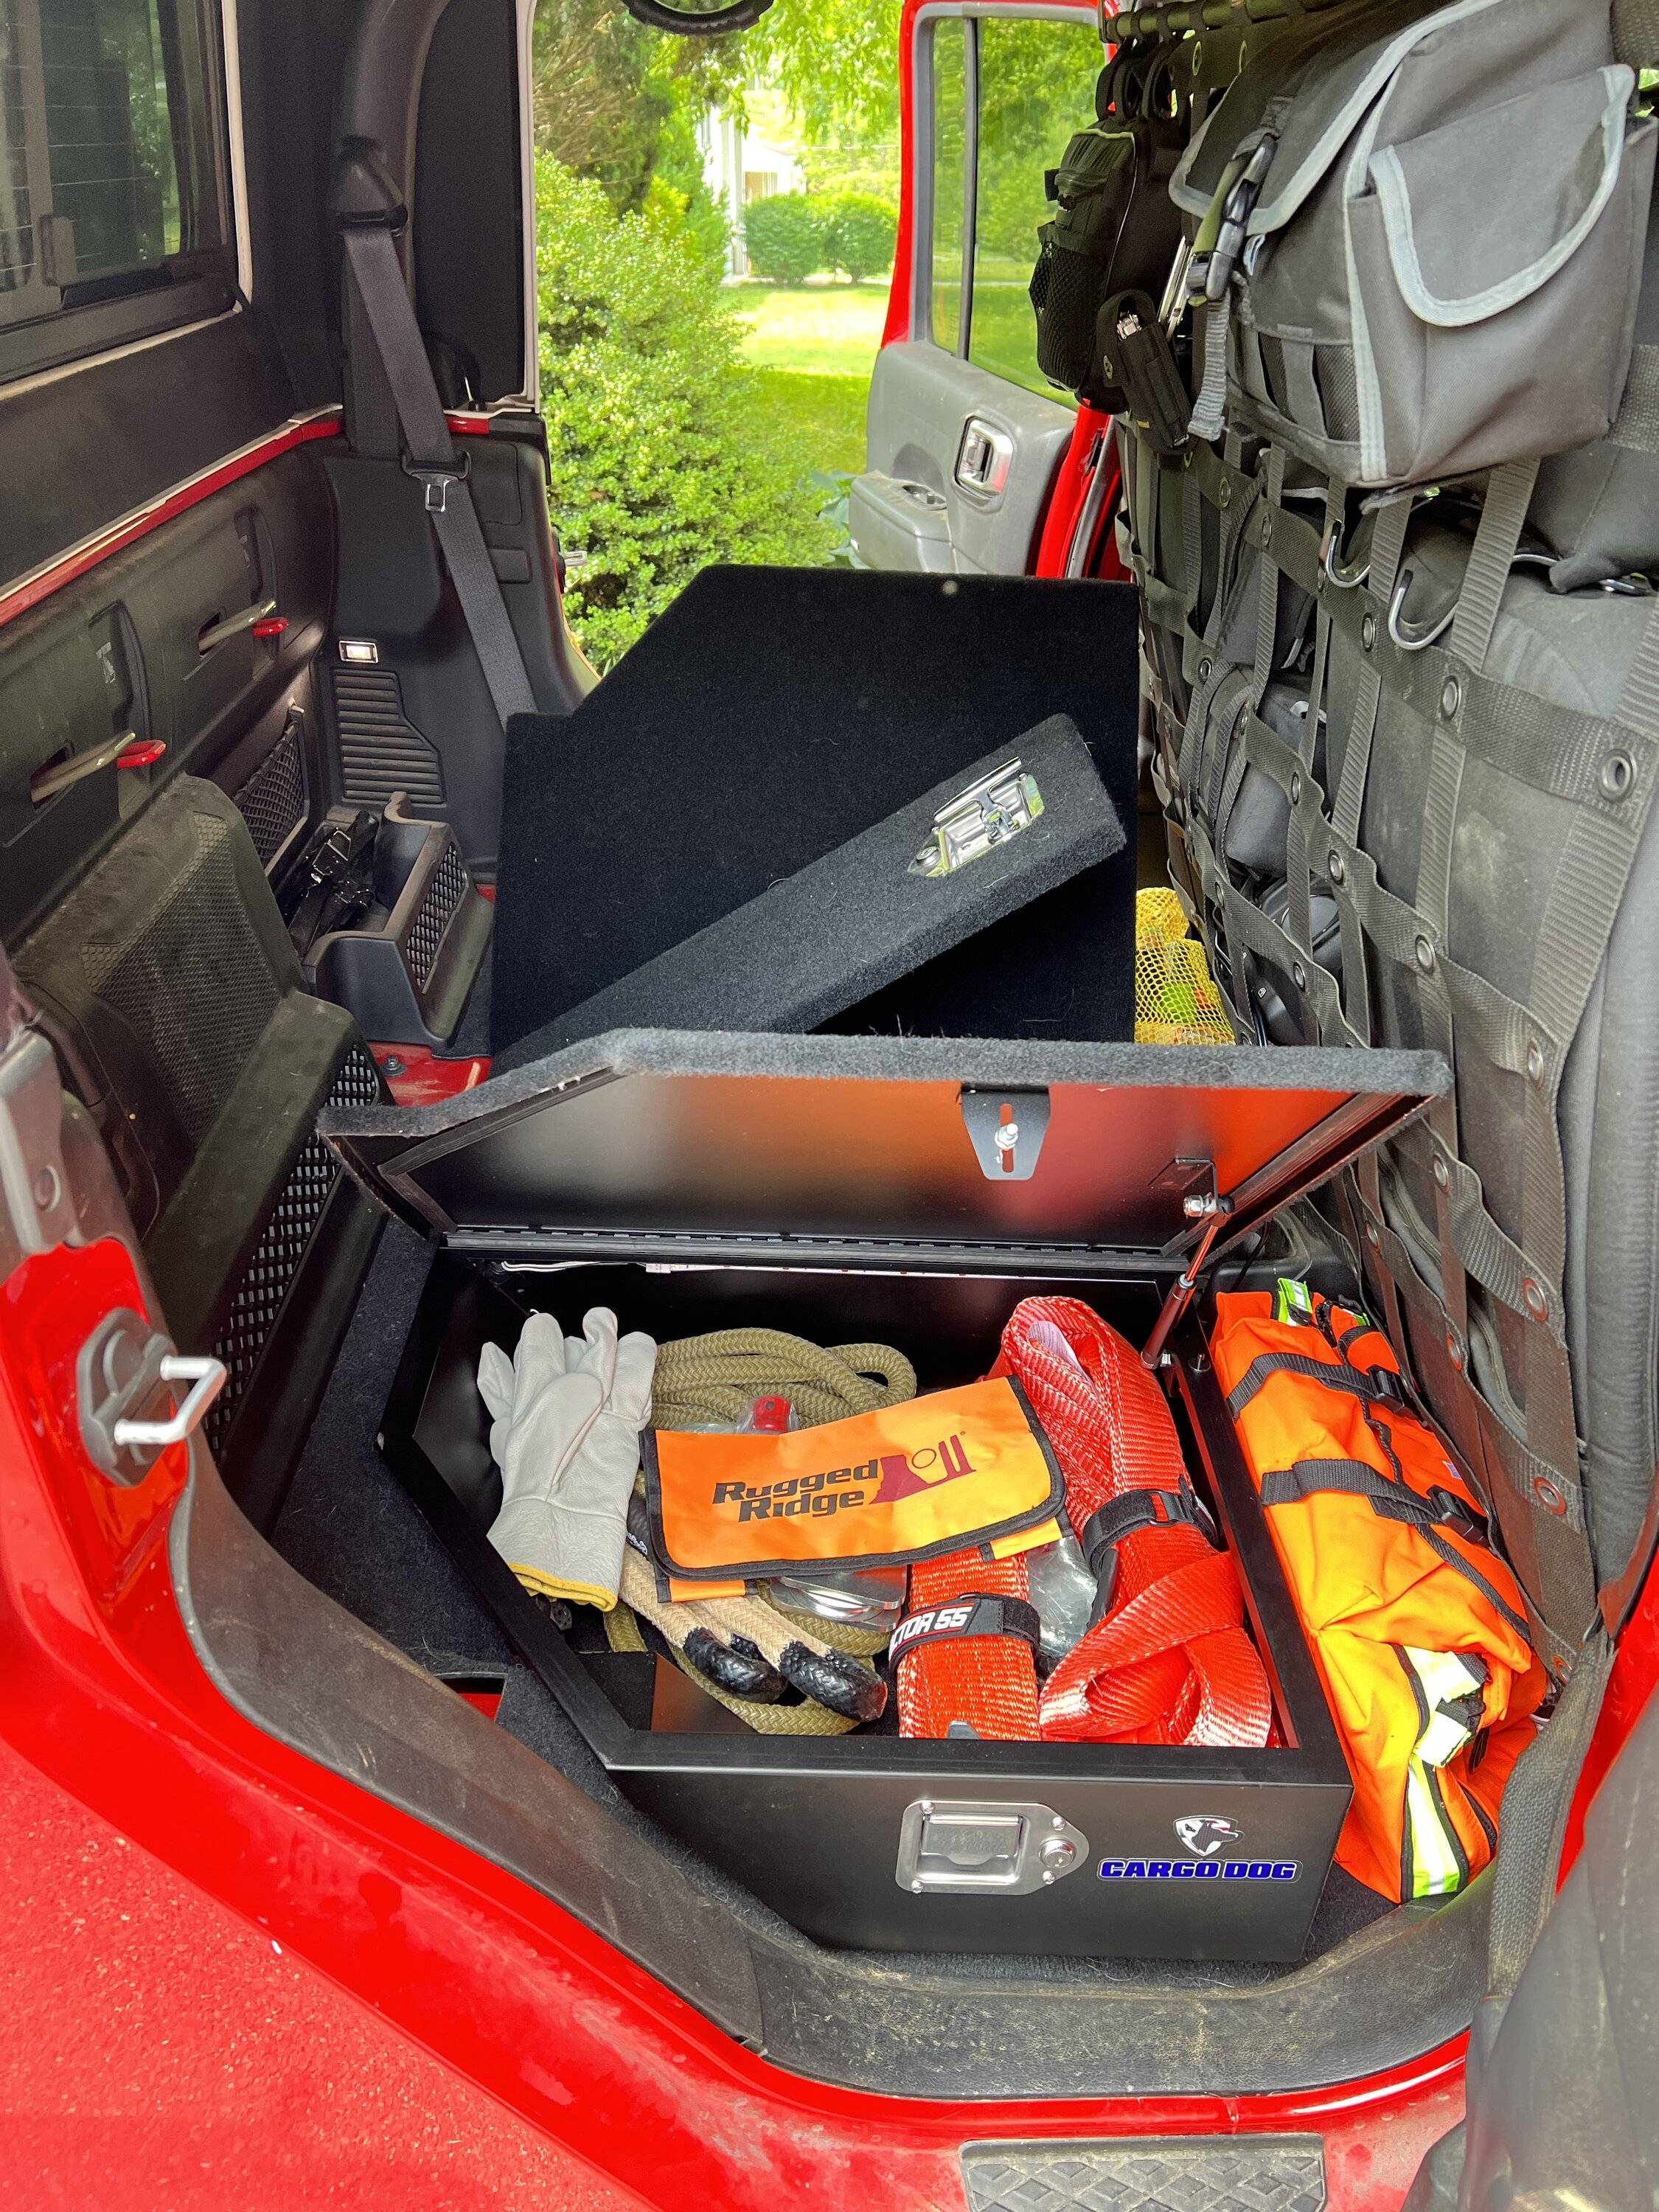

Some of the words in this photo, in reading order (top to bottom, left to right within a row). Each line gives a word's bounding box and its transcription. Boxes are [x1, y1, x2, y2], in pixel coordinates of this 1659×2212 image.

[712, 1458, 878, 1504] Rugged
[739, 1490, 864, 1523] Ridge
[888, 1611, 936, 1658] CTOR
[933, 1607, 973, 1630] 55
[1099, 1860, 1221, 1879] CARGO
[1222, 1861, 1297, 1879] DOG
